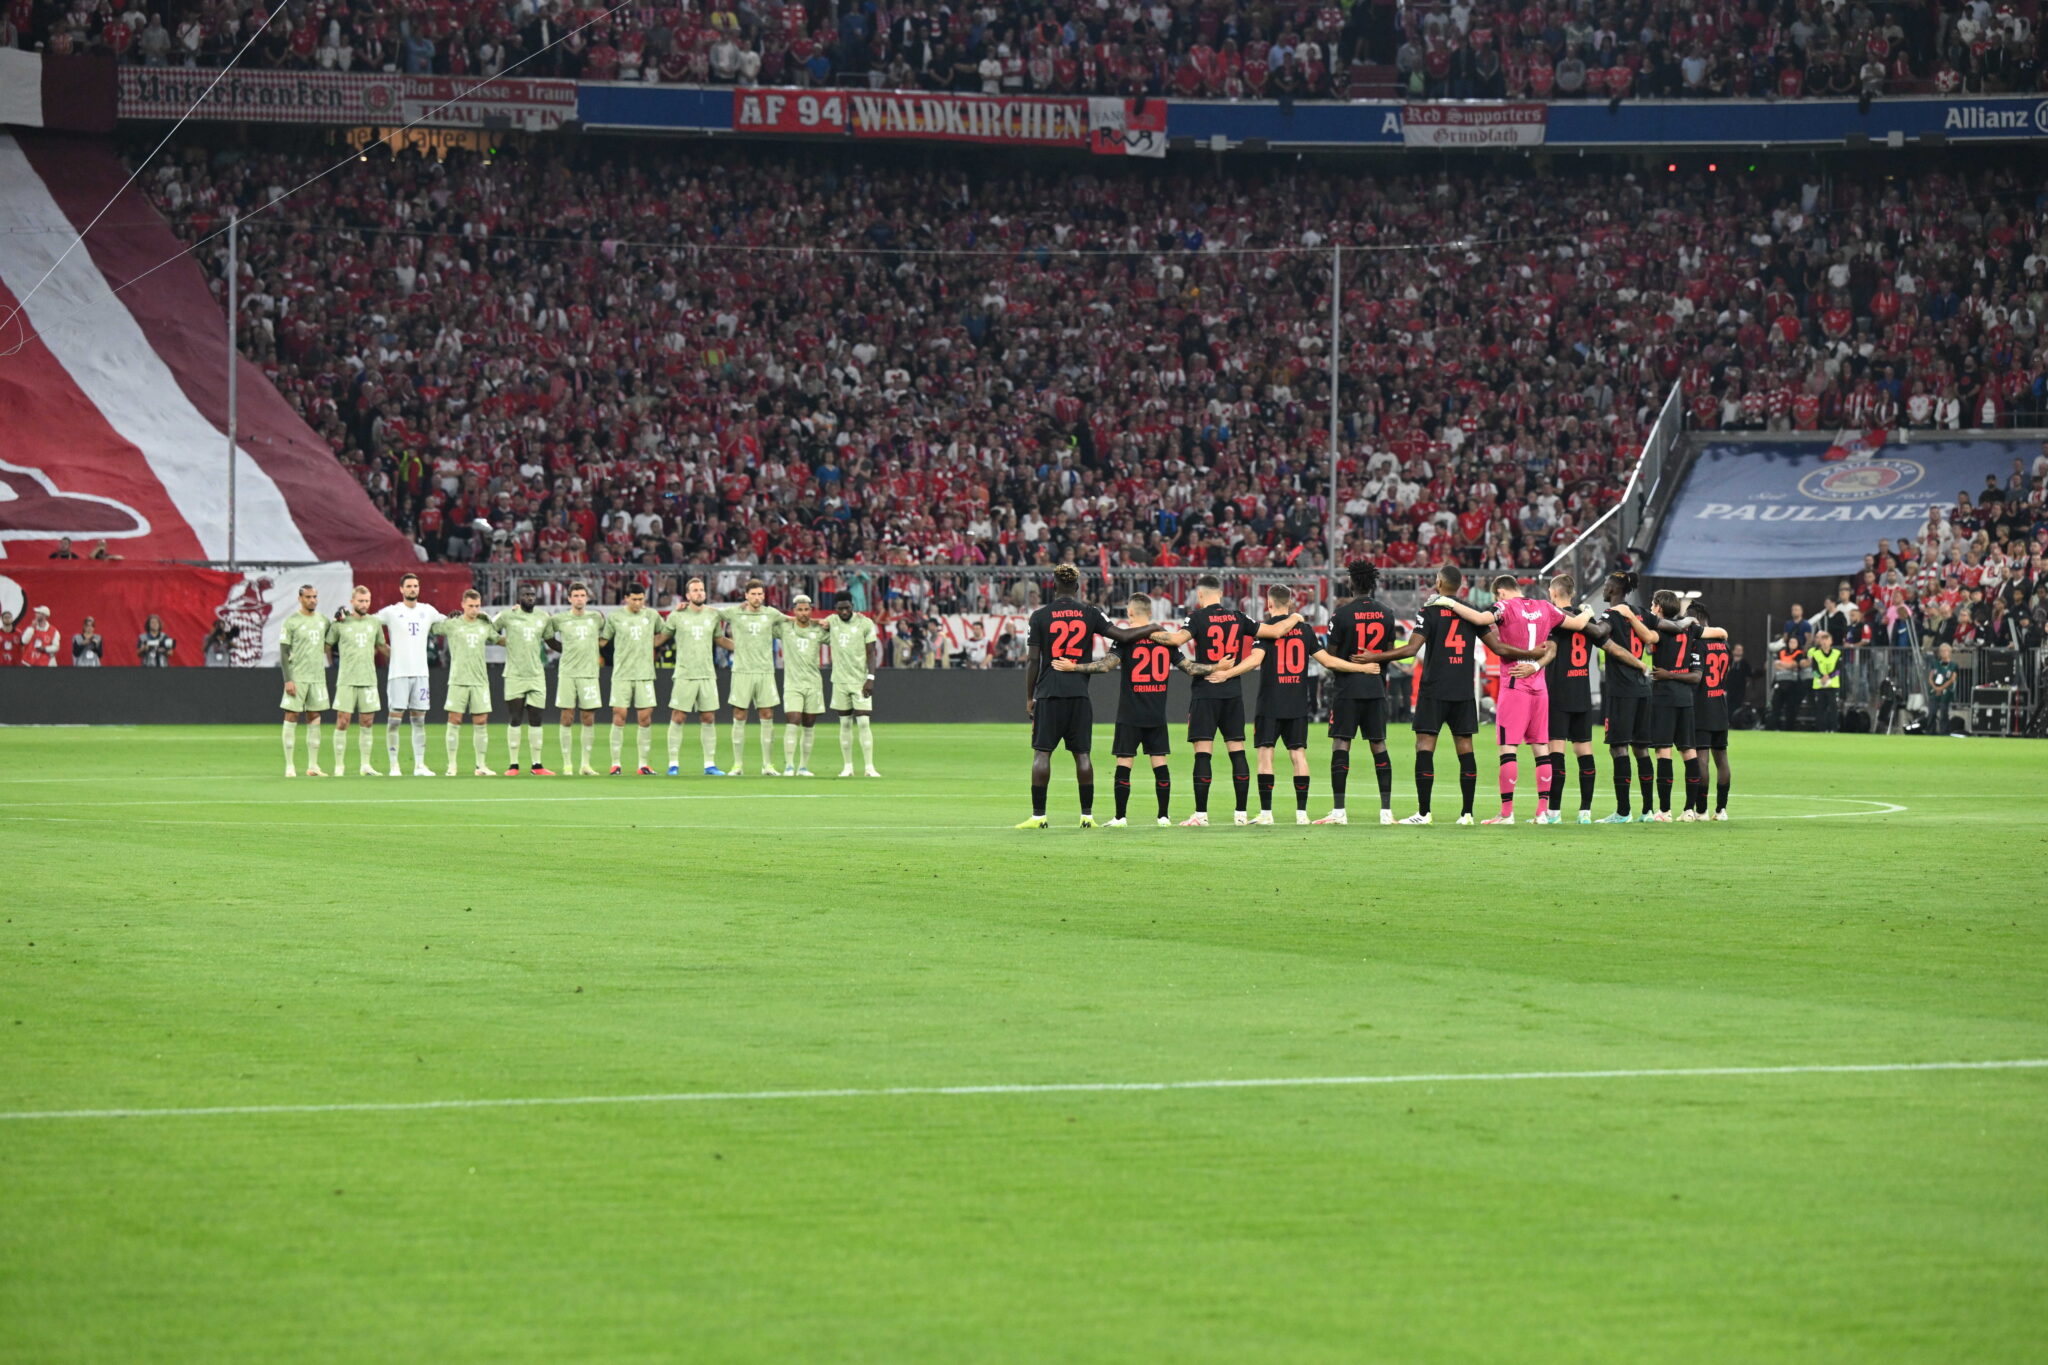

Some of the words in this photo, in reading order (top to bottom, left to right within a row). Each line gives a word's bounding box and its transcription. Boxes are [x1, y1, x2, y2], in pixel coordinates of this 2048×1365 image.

[405, 79, 434, 96] Rot
[739, 95, 786, 124] AF
[797, 96, 842, 125] 94
[1406, 107, 1441, 123] Red
[1447, 108, 1541, 126] Supporters
[852, 96, 1083, 140] WALDKIRCHEN
[1944, 107, 2029, 129] Allianz
[1694, 502, 1957, 521] PAULANER
[1051, 609, 1084, 619] BAYER04
[1354, 611, 1384, 620] BAYER04
[408, 623, 419, 636] T
[523, 627, 536, 641] T
[576, 626, 588, 640] T
[631, 626, 643, 640] T
[692, 626, 704, 640] T
[749, 622, 761, 636] T
[1444, 618, 1467, 655] 4
[309, 630, 320, 645] T
[355, 633, 367, 648] T
[466, 634, 479, 648] T
[839, 633, 849, 648] T
[1049, 619, 1087, 658] 22
[1207, 623, 1240, 662] 34
[1355, 622, 1385, 655] 12
[1527, 623, 1537, 651] 1
[1630, 627, 1644, 659] 6
[797, 638, 809, 652] T
[1571, 631, 1588, 667] 8
[1675, 633, 1688, 668] 7
[1274, 637, 1305, 674] 10
[1448, 656, 1464, 665] TAH
[1131, 645, 1170, 683] 20
[1278, 675, 1301, 684] WIRTZ
[584, 686, 598, 700] 25
[1133, 684, 1167, 693] GRIMALDO
